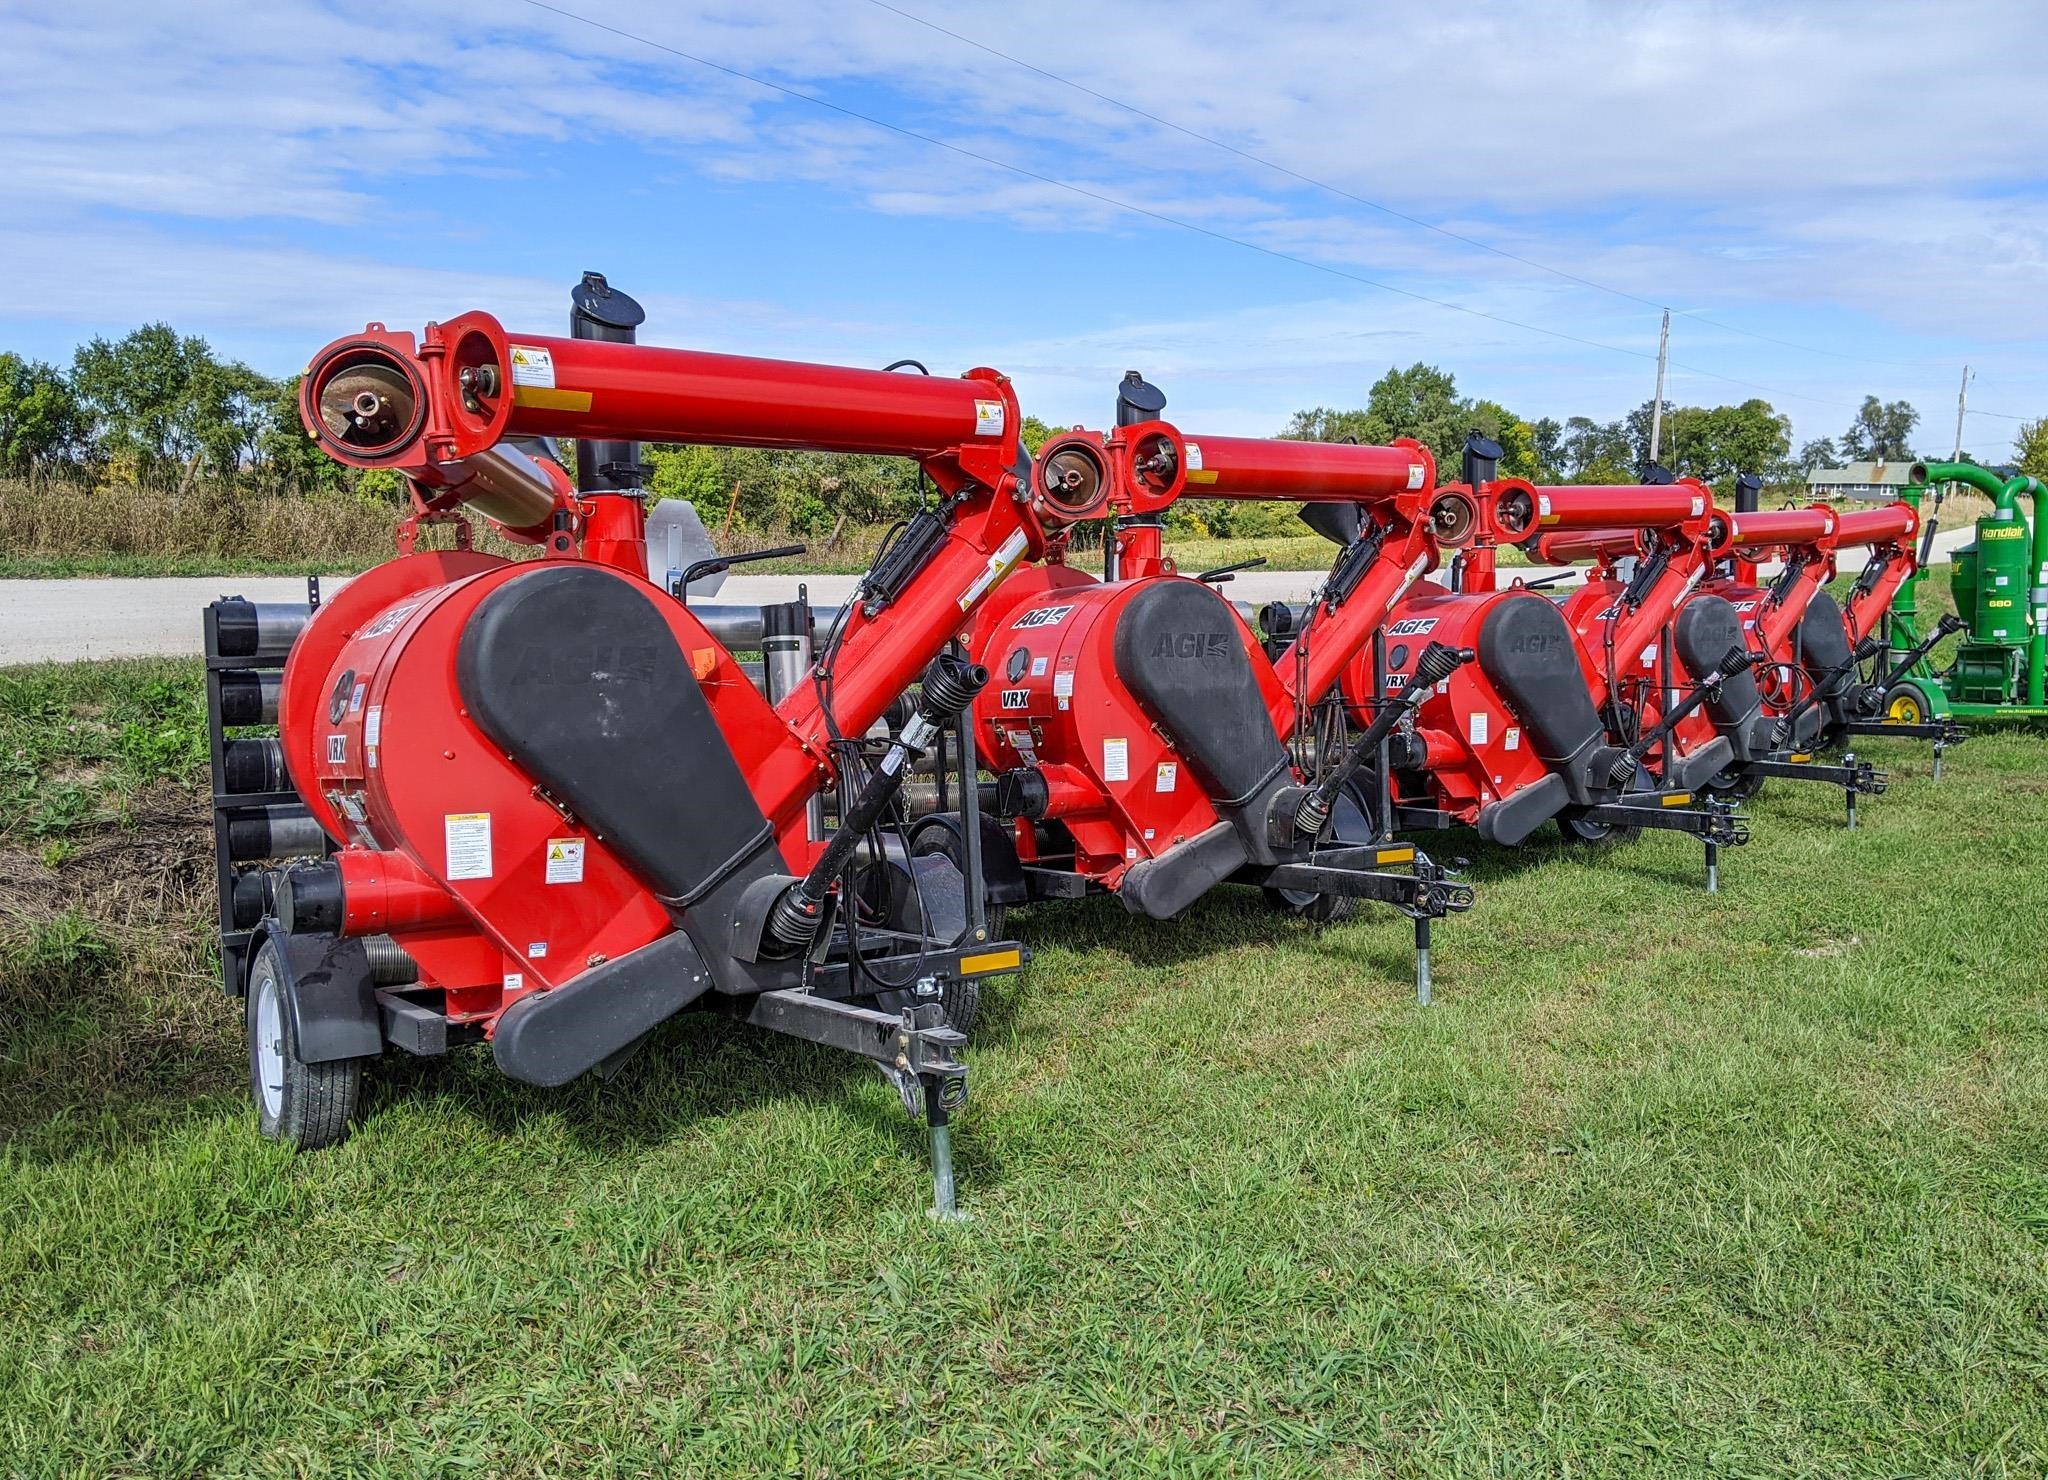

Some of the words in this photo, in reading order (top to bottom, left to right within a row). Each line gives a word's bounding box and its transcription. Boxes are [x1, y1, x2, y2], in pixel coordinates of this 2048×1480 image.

[1982, 526, 2025, 538] Handlair
[1989, 600, 2012, 608] 680
[1014, 608, 1051, 627] AGI
[1388, 620, 1421, 634] AGI
[1152, 632, 1206, 658] AGI
[1002, 691, 1029, 708] VRX
[328, 737, 345, 762] VRX
